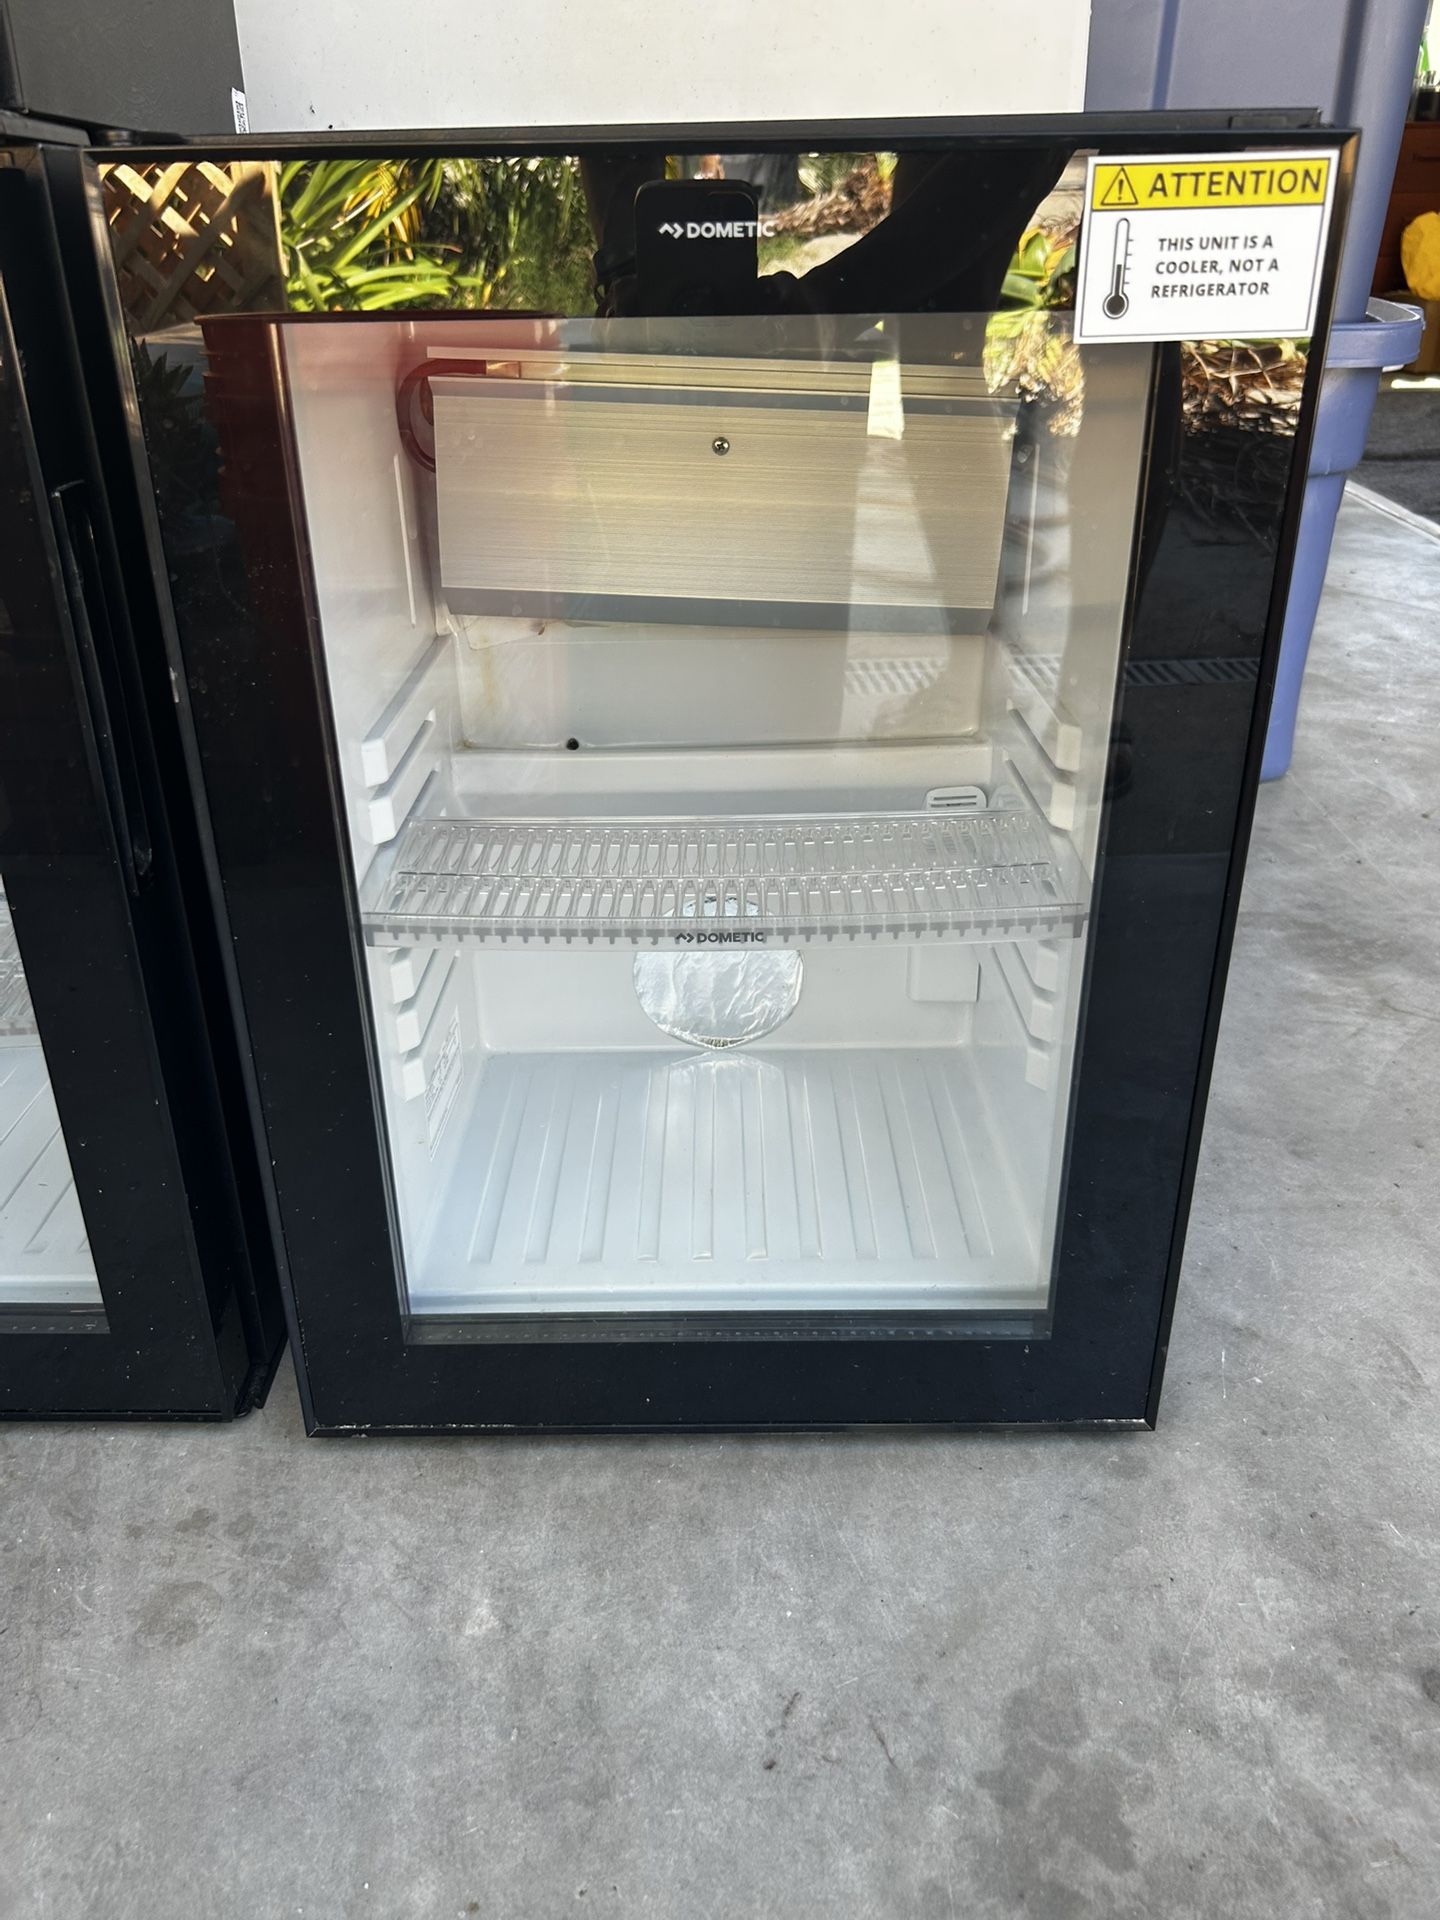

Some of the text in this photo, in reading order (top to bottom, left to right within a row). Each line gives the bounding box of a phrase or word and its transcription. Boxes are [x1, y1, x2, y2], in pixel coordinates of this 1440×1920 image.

[1149, 168, 1322, 198] ATTENTION
[686, 221, 776, 239] DOMETIC
[1158, 235, 1274, 252] THIS UNIT IS A
[1155, 258, 1280, 276] COOLER, NOT A
[1151, 282, 1270, 298] REFRIGERATOR
[696, 931, 765, 943] DOMETIC
